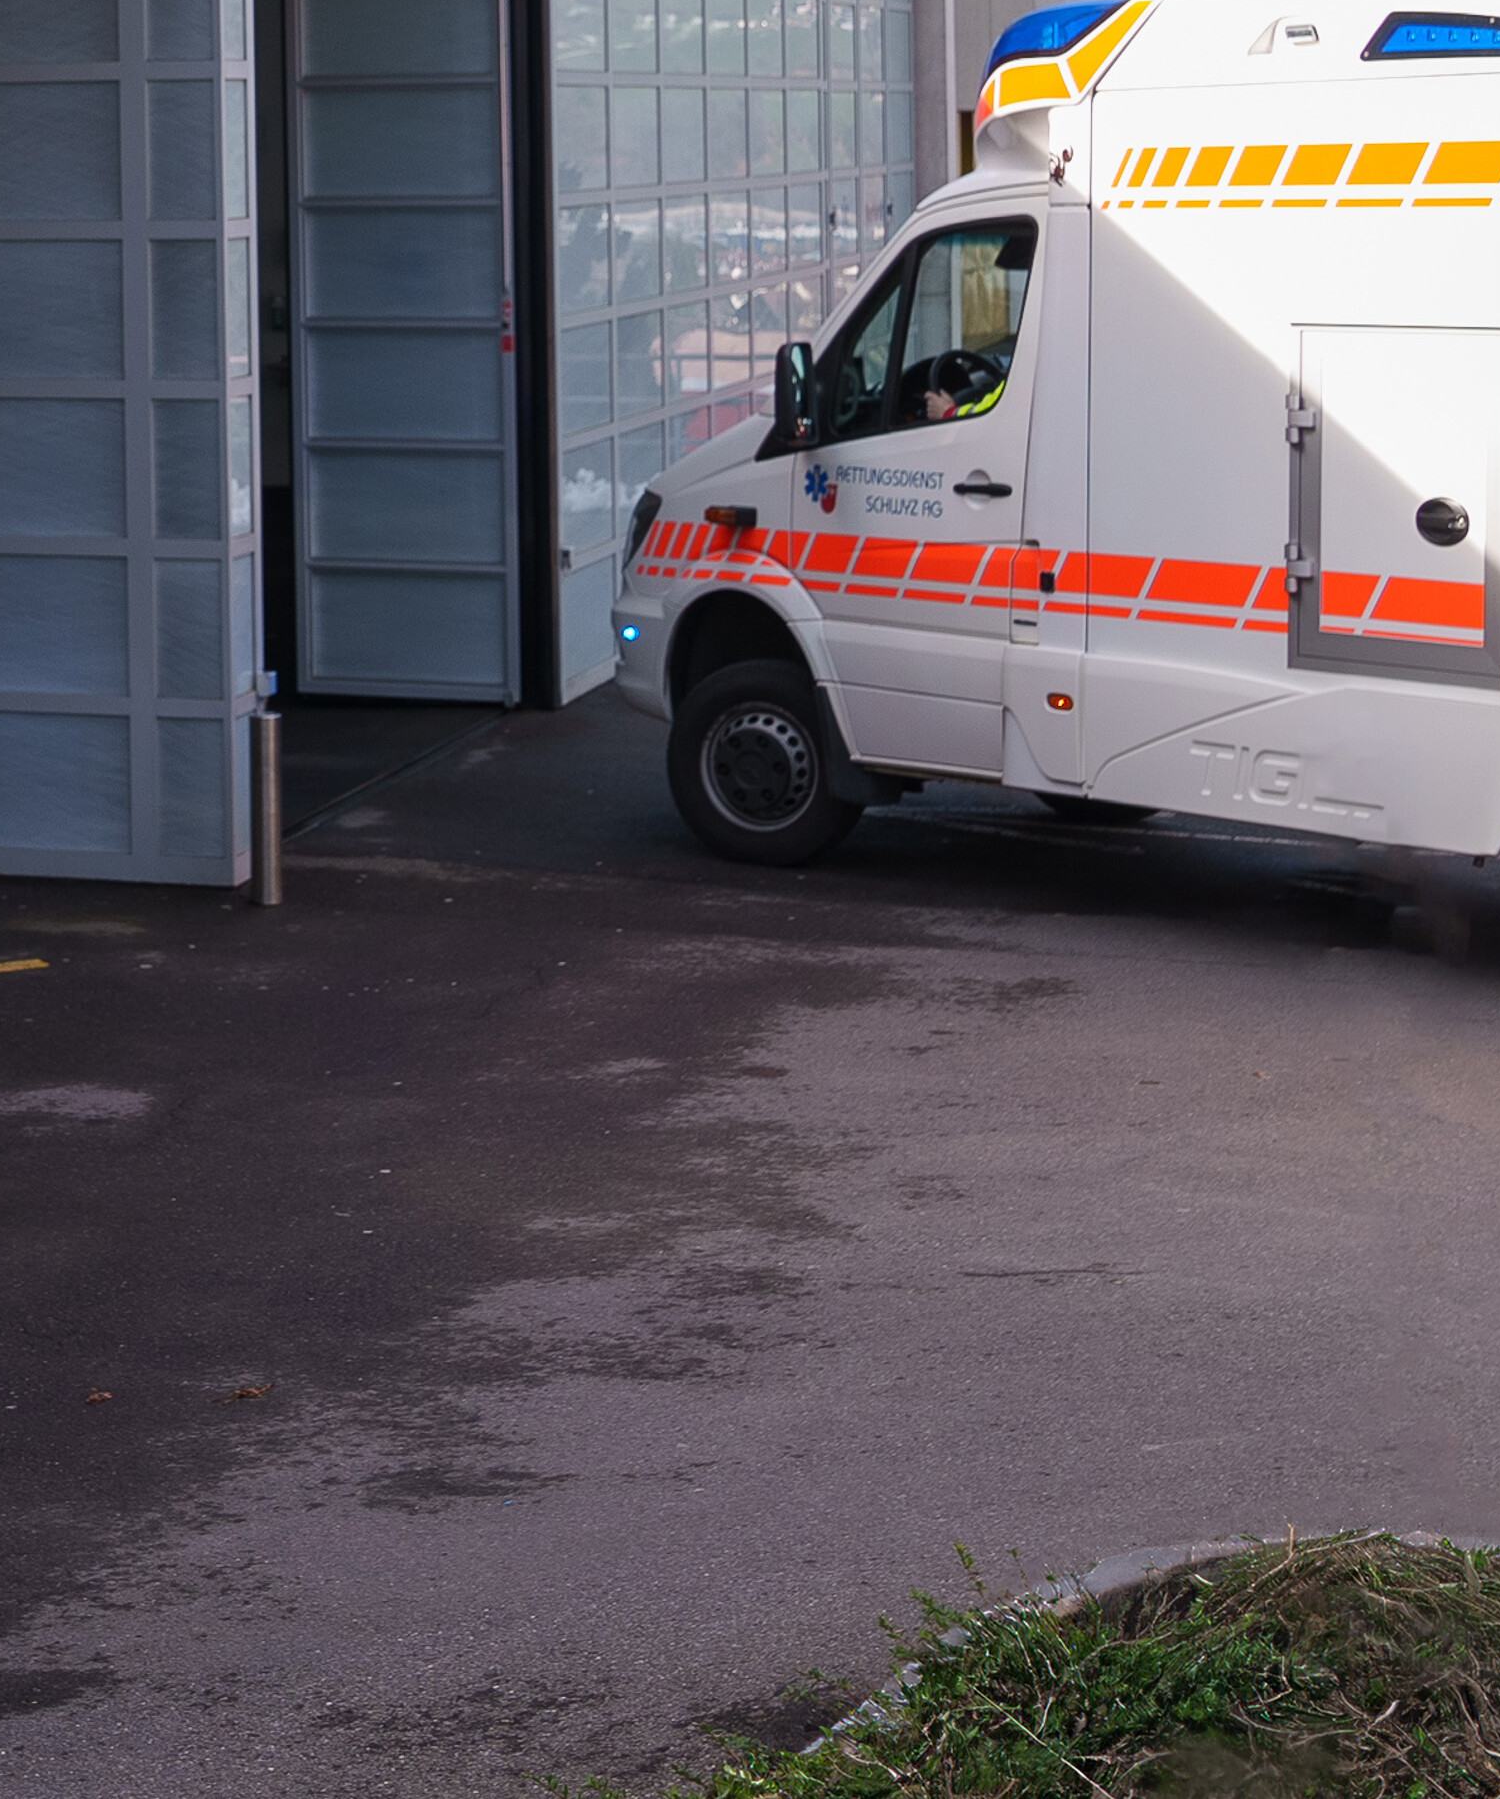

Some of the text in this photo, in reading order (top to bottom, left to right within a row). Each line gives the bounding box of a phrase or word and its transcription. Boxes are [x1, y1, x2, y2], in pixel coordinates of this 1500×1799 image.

[835, 465, 945, 490] RETTUNGSDIENST
[864, 494, 944, 519] SCHWYZ AG
